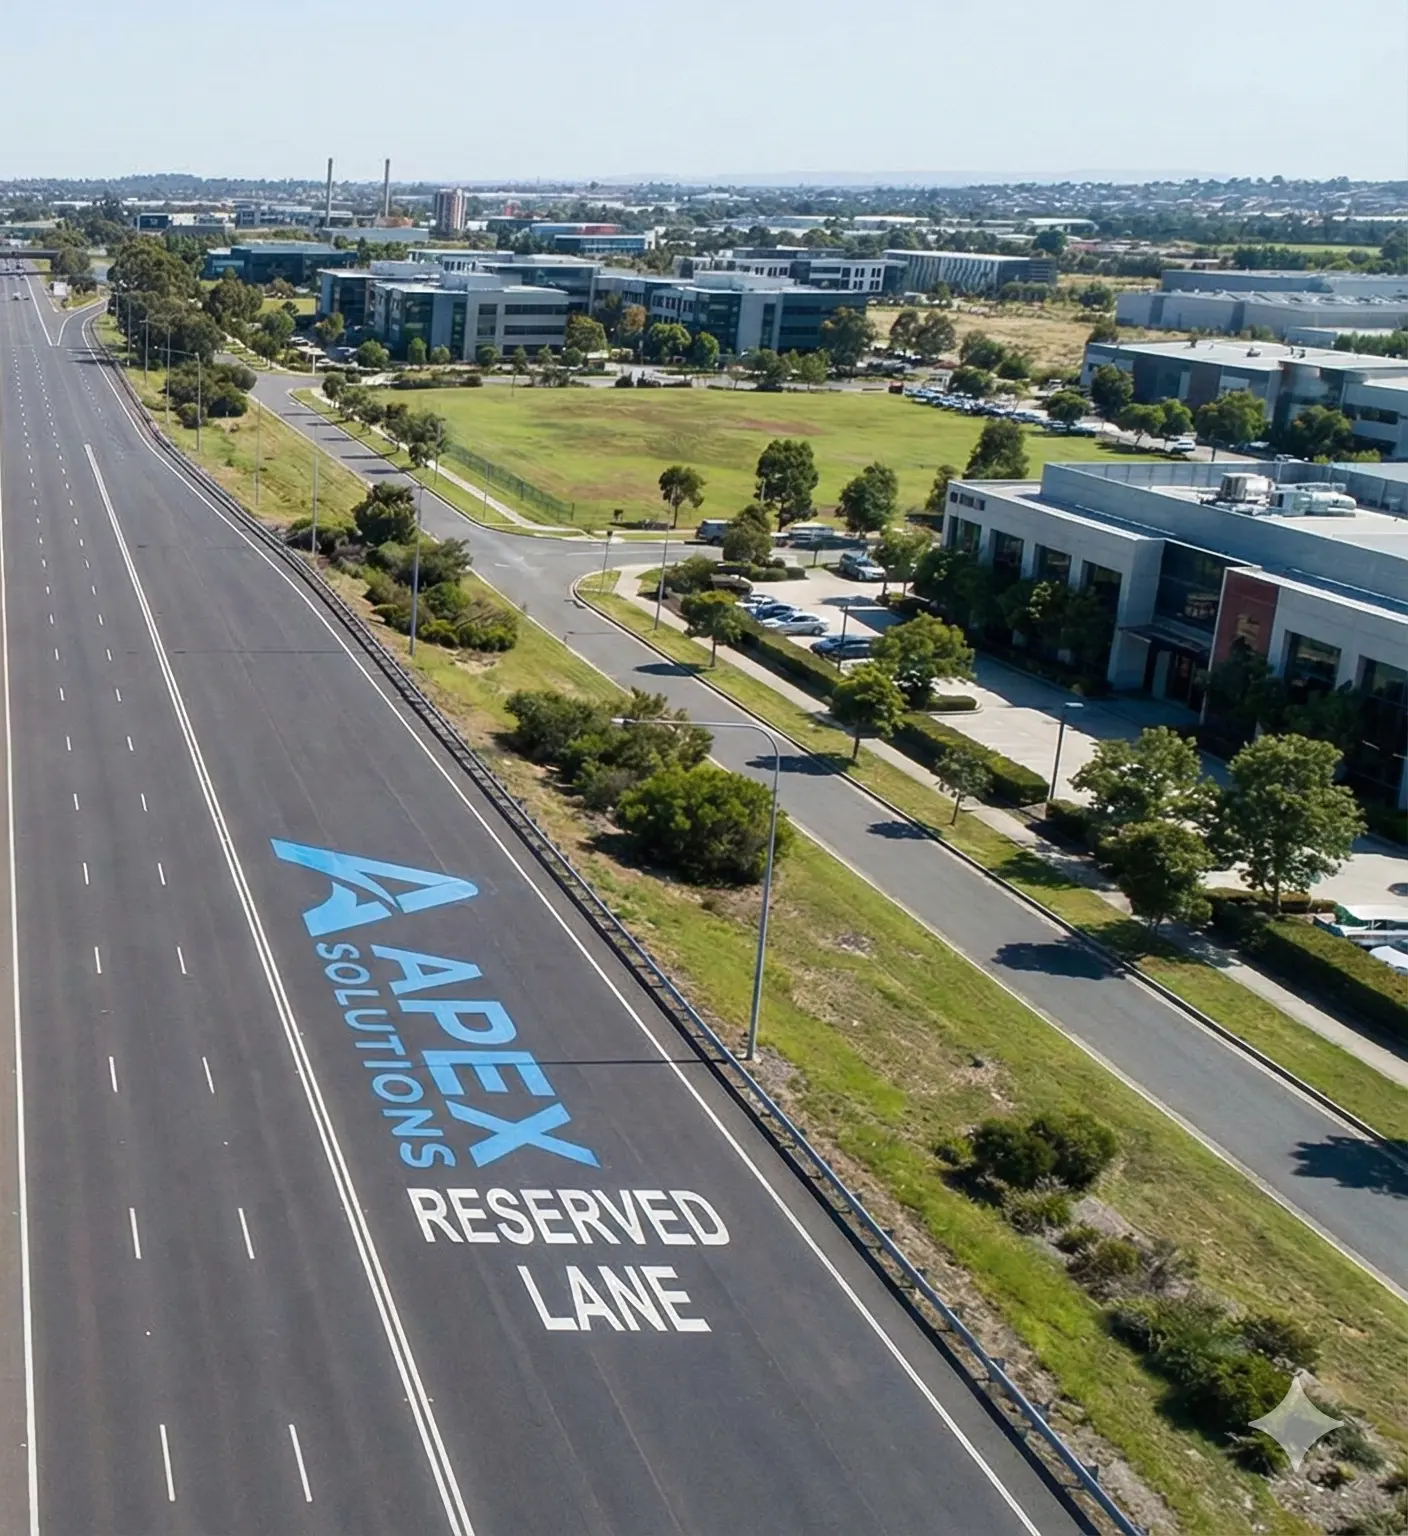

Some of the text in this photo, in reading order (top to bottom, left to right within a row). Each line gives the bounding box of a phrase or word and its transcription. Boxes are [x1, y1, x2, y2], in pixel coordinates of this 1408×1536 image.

[316, 942, 457, 1169] SOLUTIONS
[370, 943, 602, 1169] APEX
[406, 1187, 731, 1246] RESERVED
[517, 1265, 712, 1332] LANE
